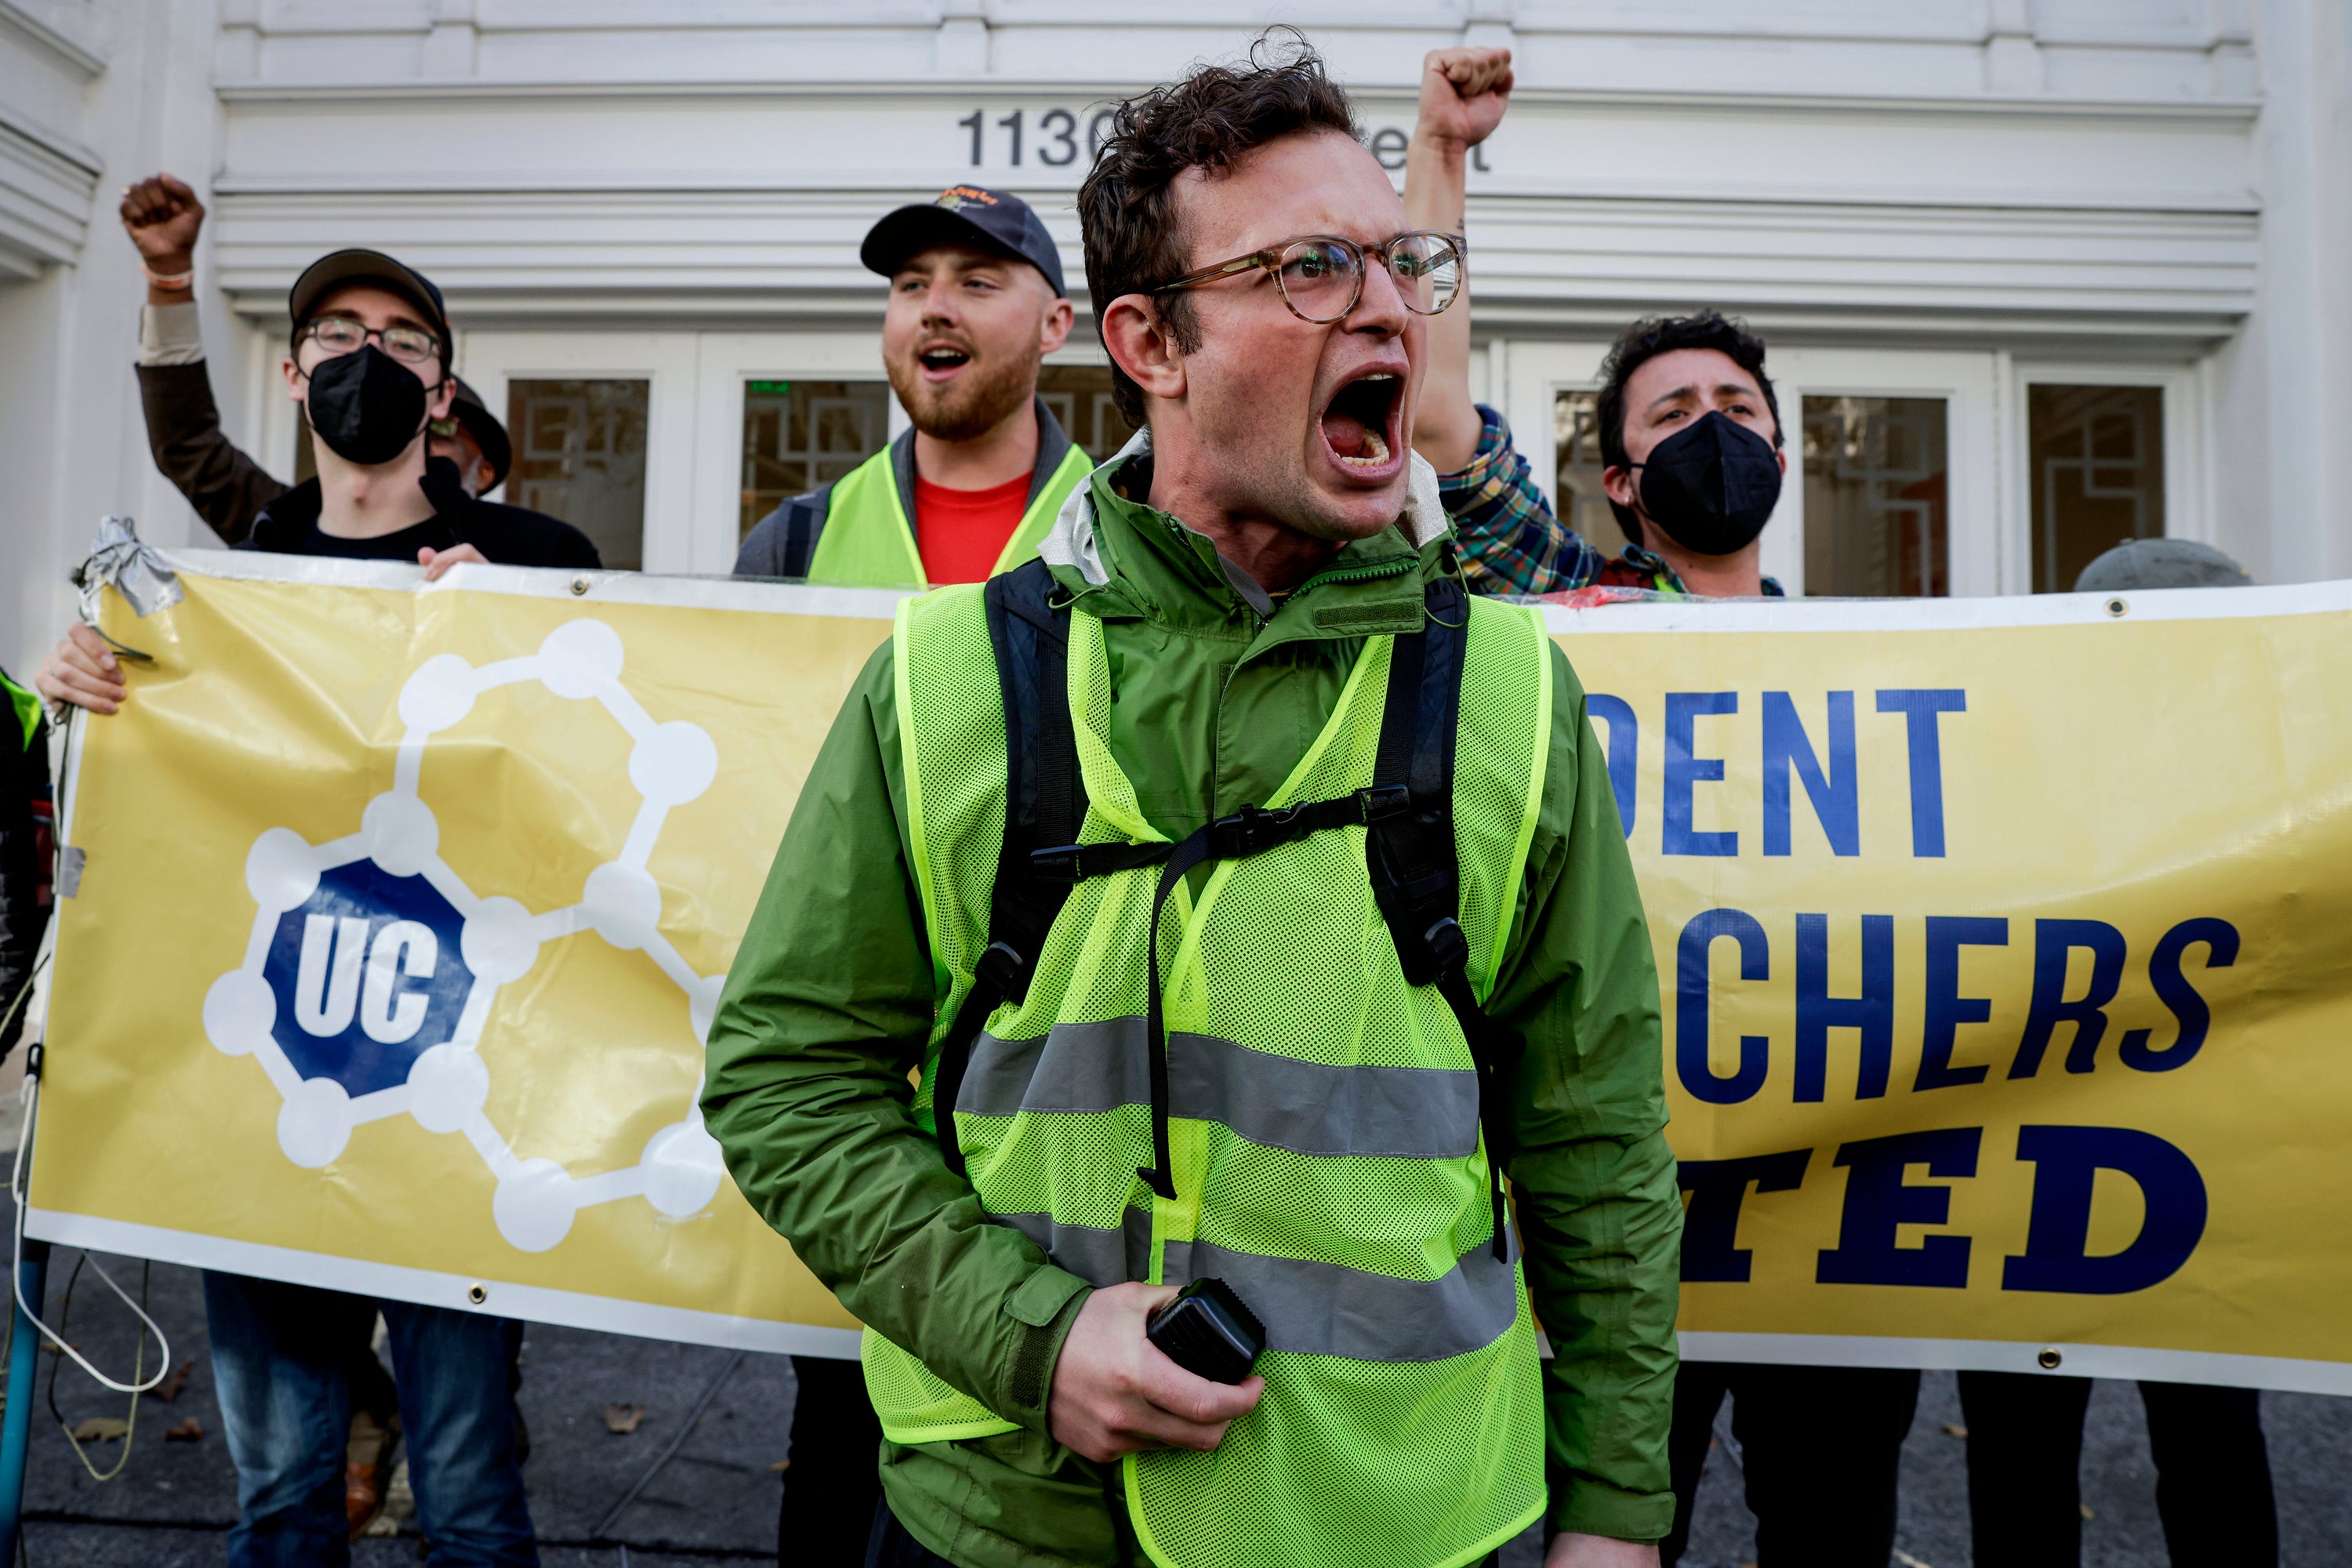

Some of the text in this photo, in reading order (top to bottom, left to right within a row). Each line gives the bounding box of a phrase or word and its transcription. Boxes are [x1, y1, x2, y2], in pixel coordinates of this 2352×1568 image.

[294, 913, 439, 1044] UC
[1676, 908, 2241, 1105] CHERS
[1677, 1124, 2209, 1295] TED
